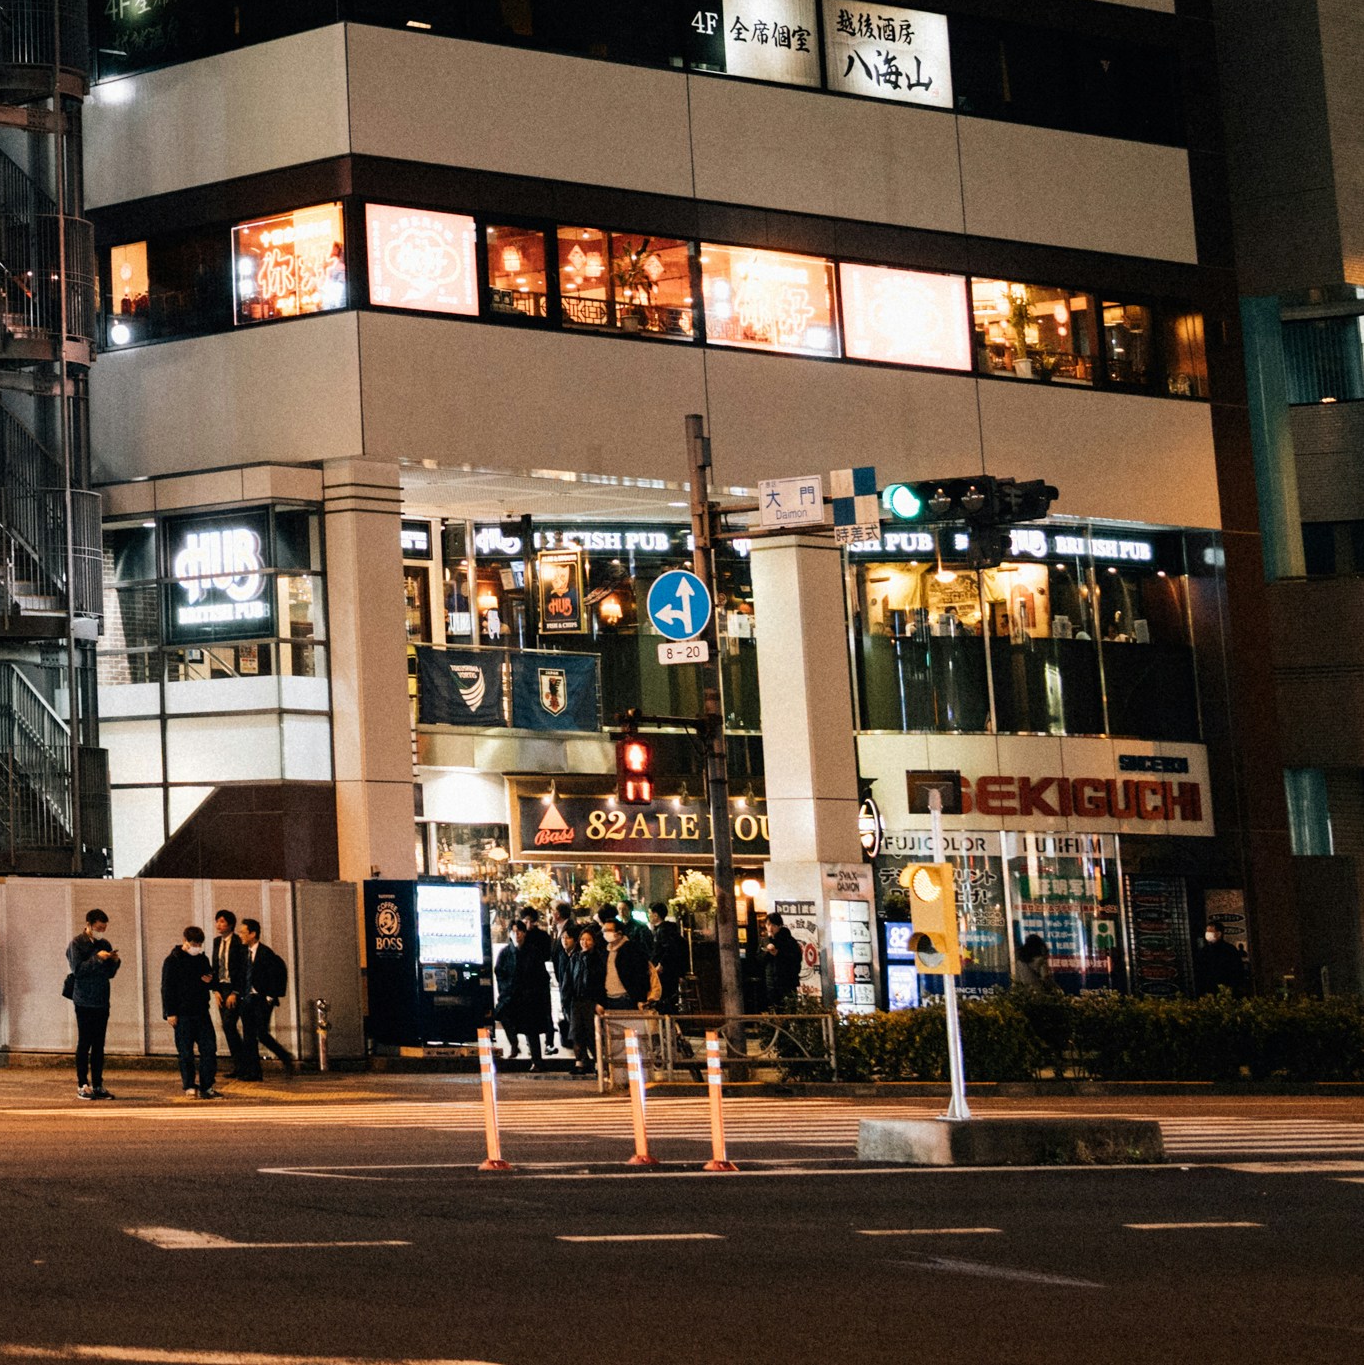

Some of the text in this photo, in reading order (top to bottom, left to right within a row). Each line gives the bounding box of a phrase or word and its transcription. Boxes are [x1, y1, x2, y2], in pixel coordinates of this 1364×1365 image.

[691, 11, 719, 35] 4F
[836, 8, 916, 46] 越後酒房
[729, 16, 811, 54] 全席個室
[843, 48, 933, 92] 八海山
[765, 486, 817, 509] 大門
[774, 508, 809, 520] Daimon
[626, 533, 669, 550] PUB
[834, 524, 880, 545] 時差式
[884, 533, 934, 551] PUB
[1120, 543, 1152, 561] PUB
[548, 597, 573, 617] HUB
[586, 811, 625, 840] 82
[629, 814, 700, 840] ALE
[534, 827, 575, 847] Bass
[377, 901, 399, 912] COFFEE
[376, 937, 403, 951] BOSS
